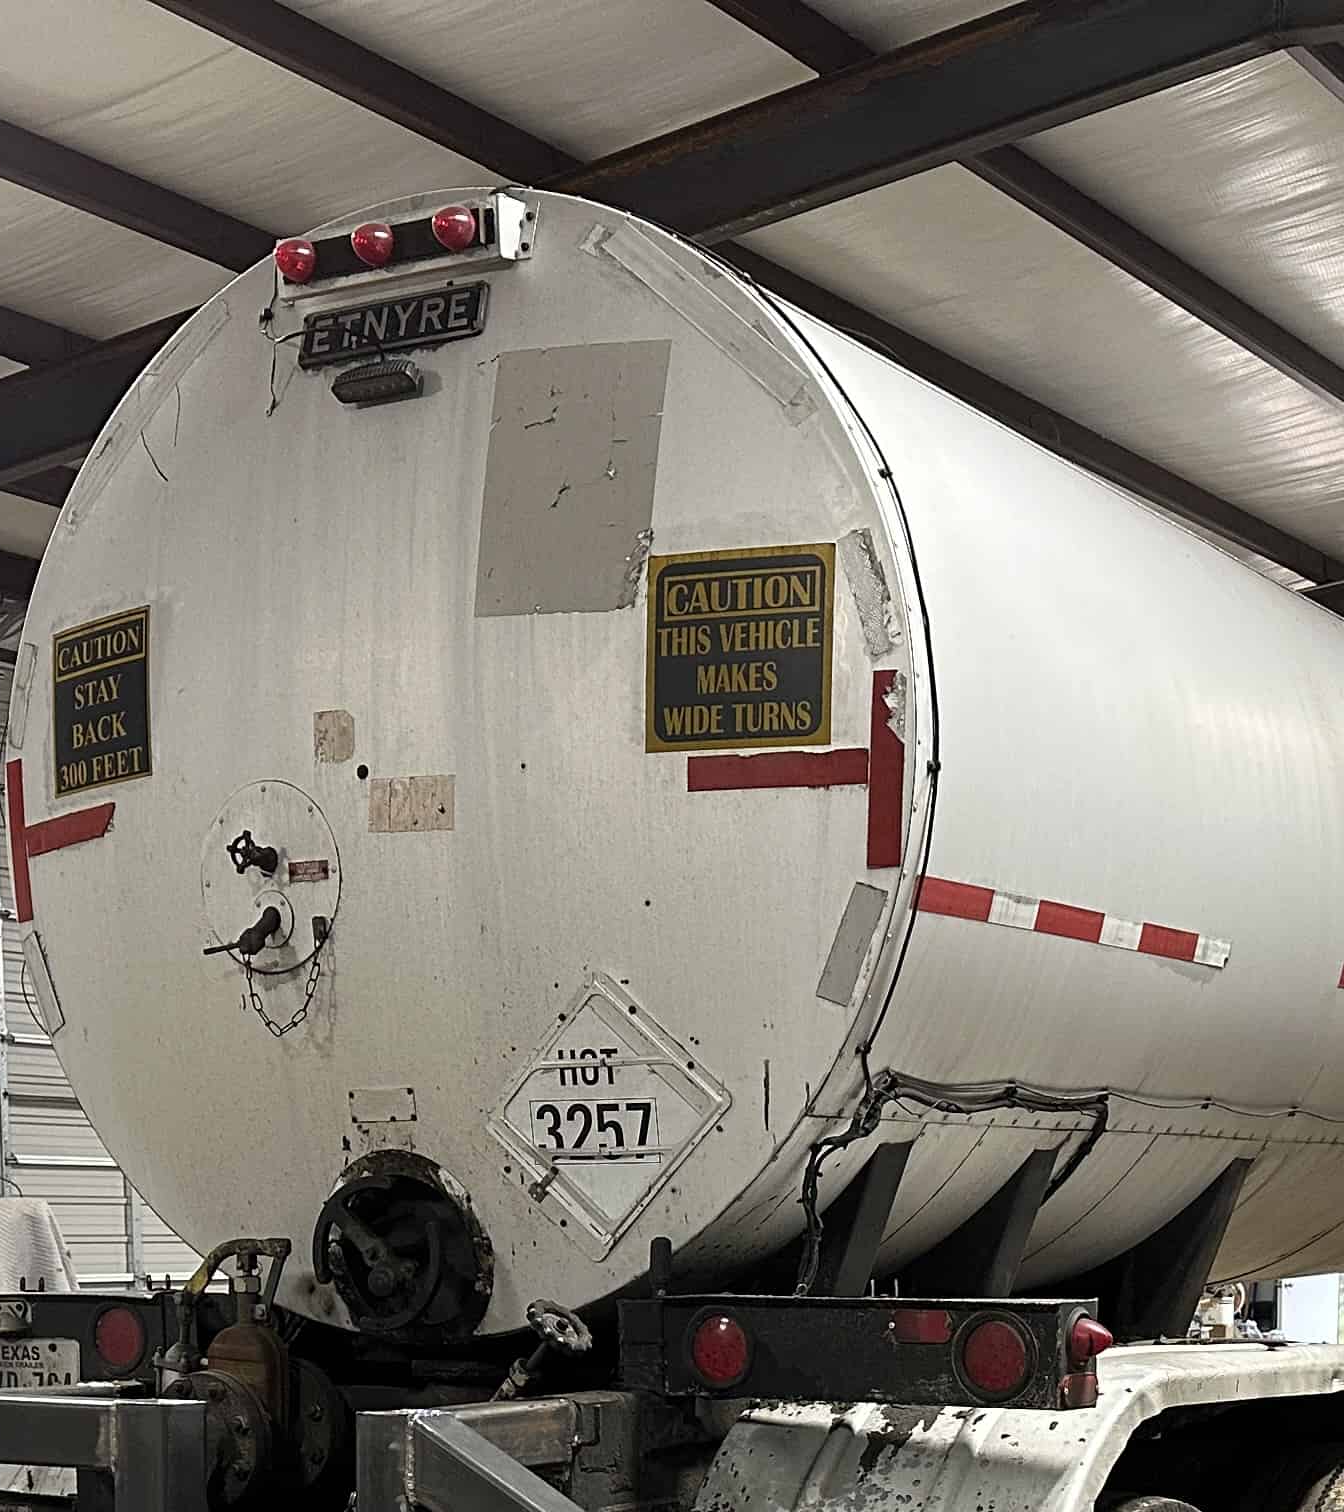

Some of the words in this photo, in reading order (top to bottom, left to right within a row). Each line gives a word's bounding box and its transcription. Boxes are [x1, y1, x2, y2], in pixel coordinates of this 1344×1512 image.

[311, 291, 471, 353] ETNYRE
[668, 573, 812, 616] CAUTION
[58, 625, 140, 671] CAUTION
[657, 625, 712, 657] THIS
[719, 618, 821, 653] VEHICLE
[74, 674, 122, 711] STAY
[696, 661, 778, 695] MAKES
[72, 711, 127, 750] BACK
[663, 704, 725, 737] WIDE
[732, 700, 812, 733] TURNS
[60, 759, 87, 791] 300
[92, 745, 144, 783] FEET
[556, 1048, 618, 1087] HOT
[534, 1102, 653, 1161] 3257
